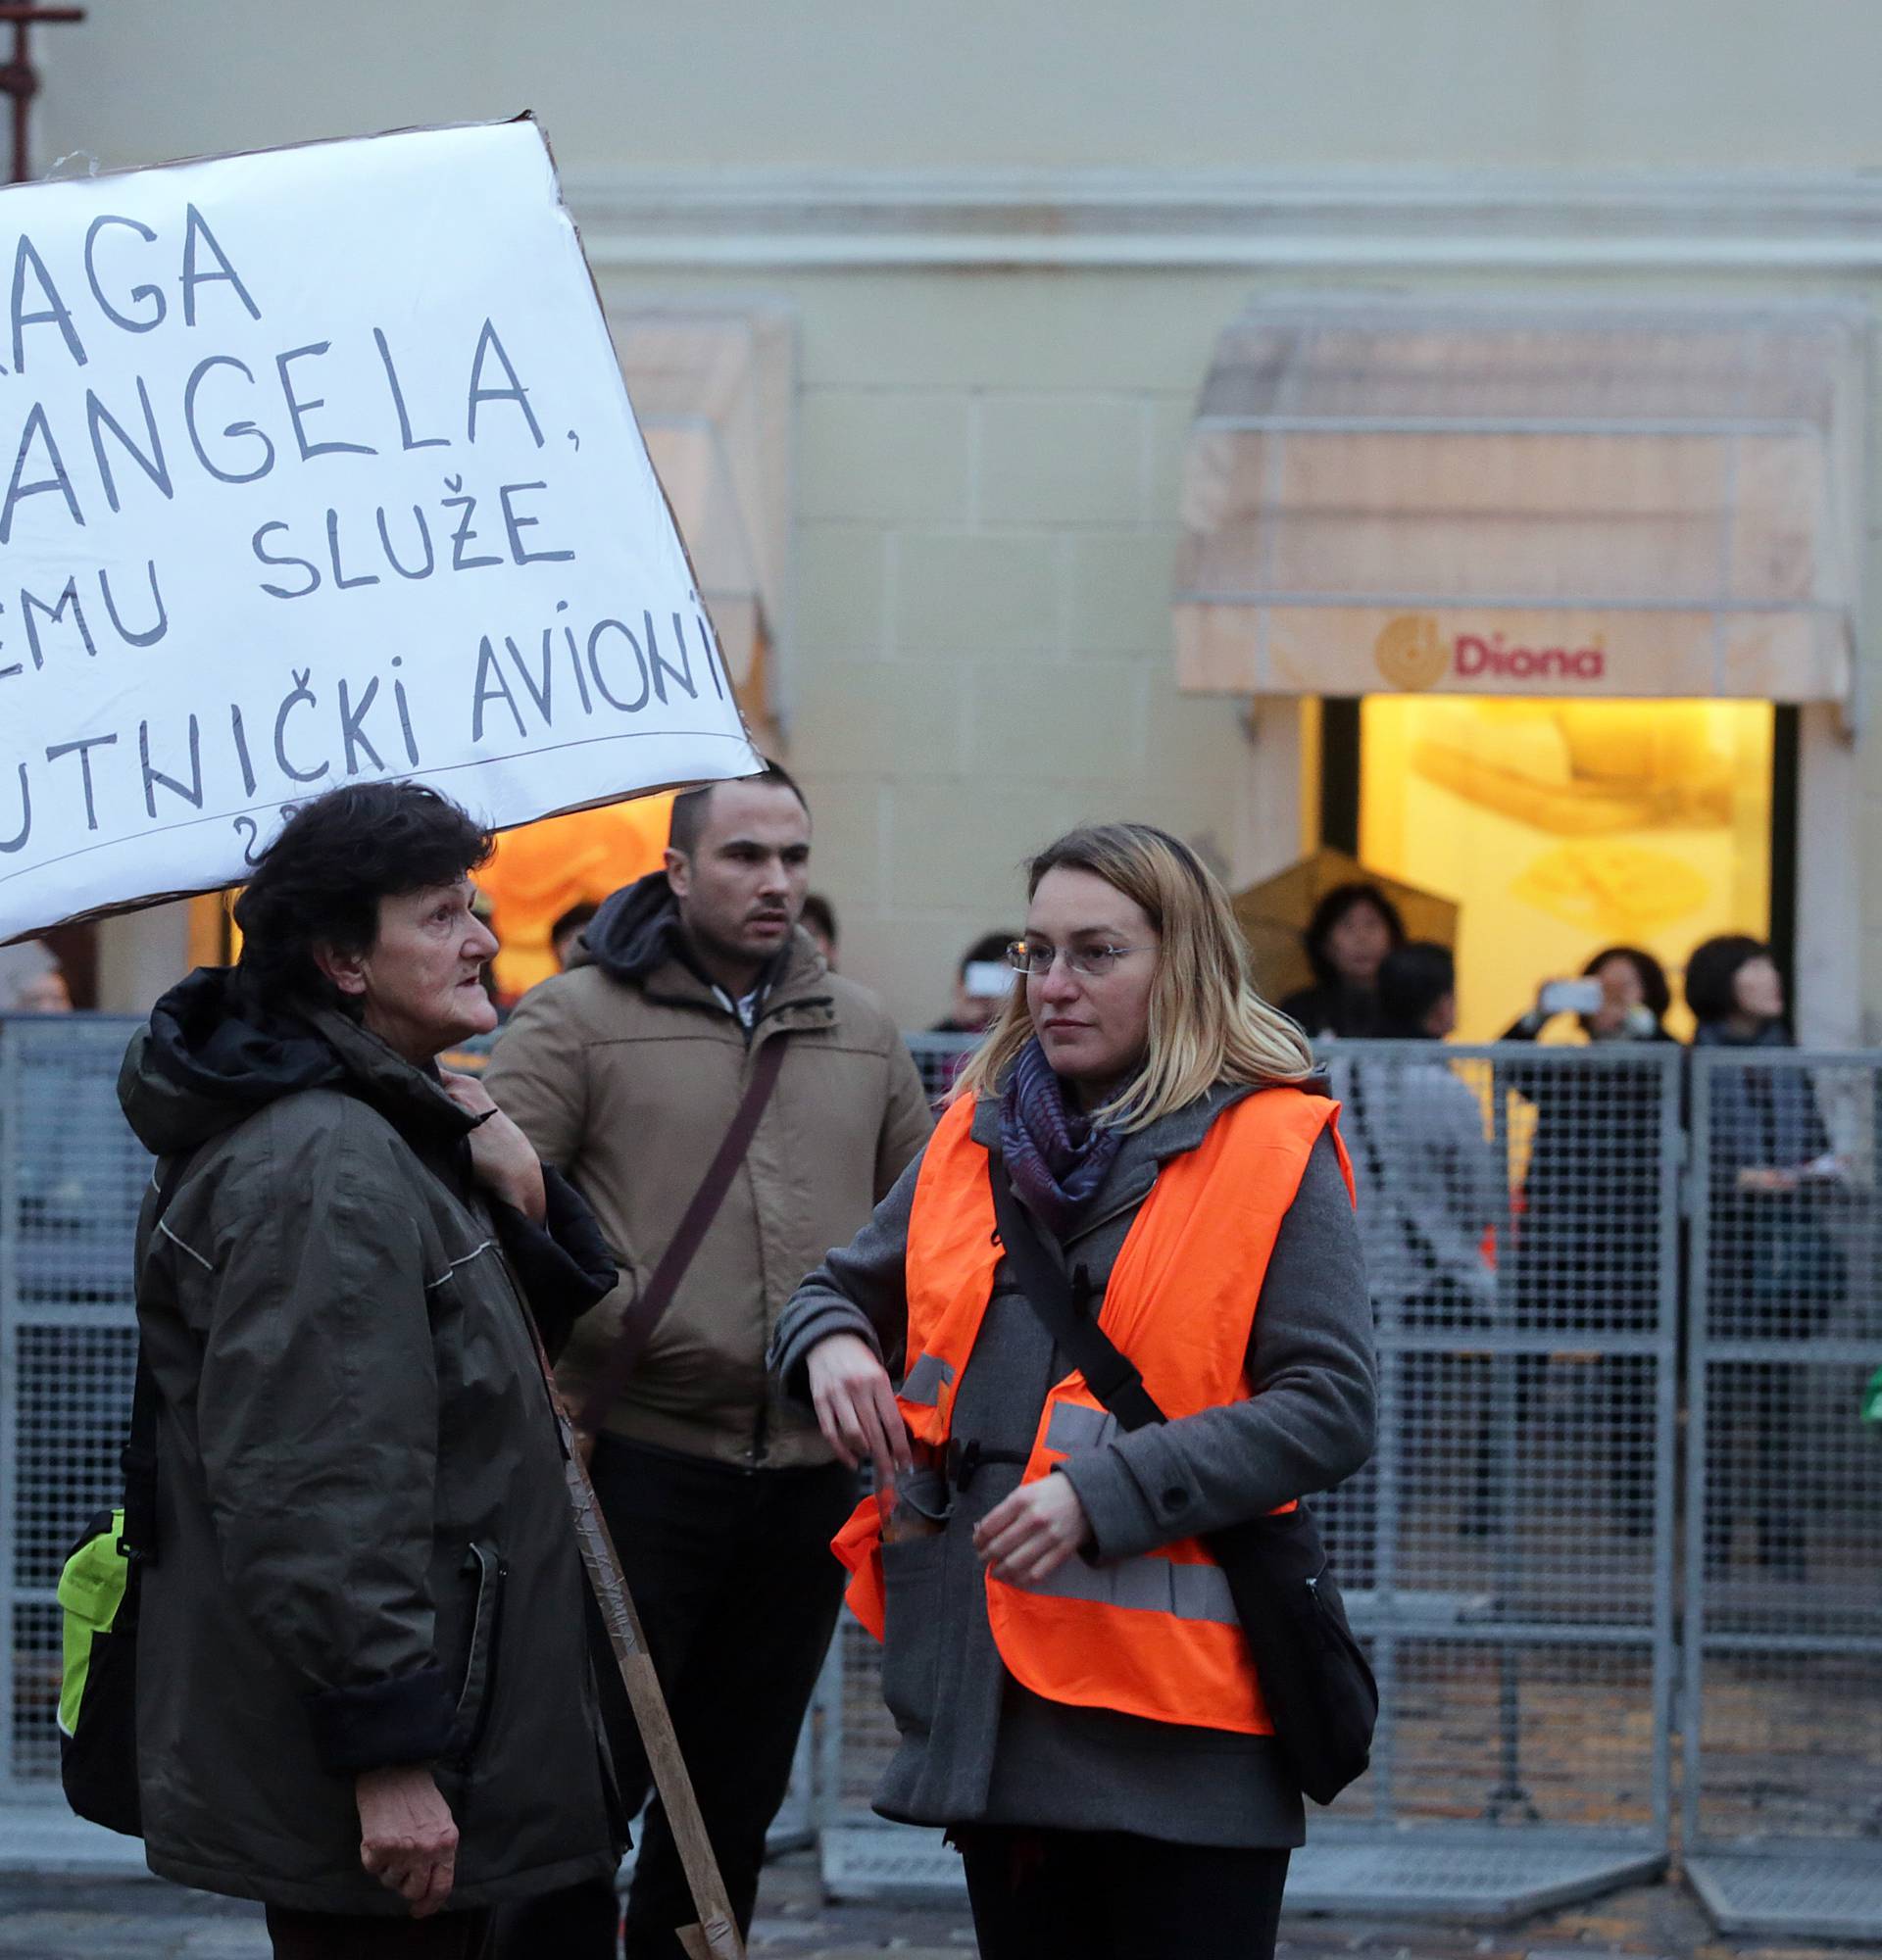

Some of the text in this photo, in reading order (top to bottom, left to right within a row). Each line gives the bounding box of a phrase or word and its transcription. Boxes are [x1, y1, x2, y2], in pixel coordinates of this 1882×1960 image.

[0, 202, 262, 376] AGA
[0, 318, 580, 545] ANGELA,
[251, 473, 575, 599] SLUŽE
[1455, 632, 1605, 679] Diona
